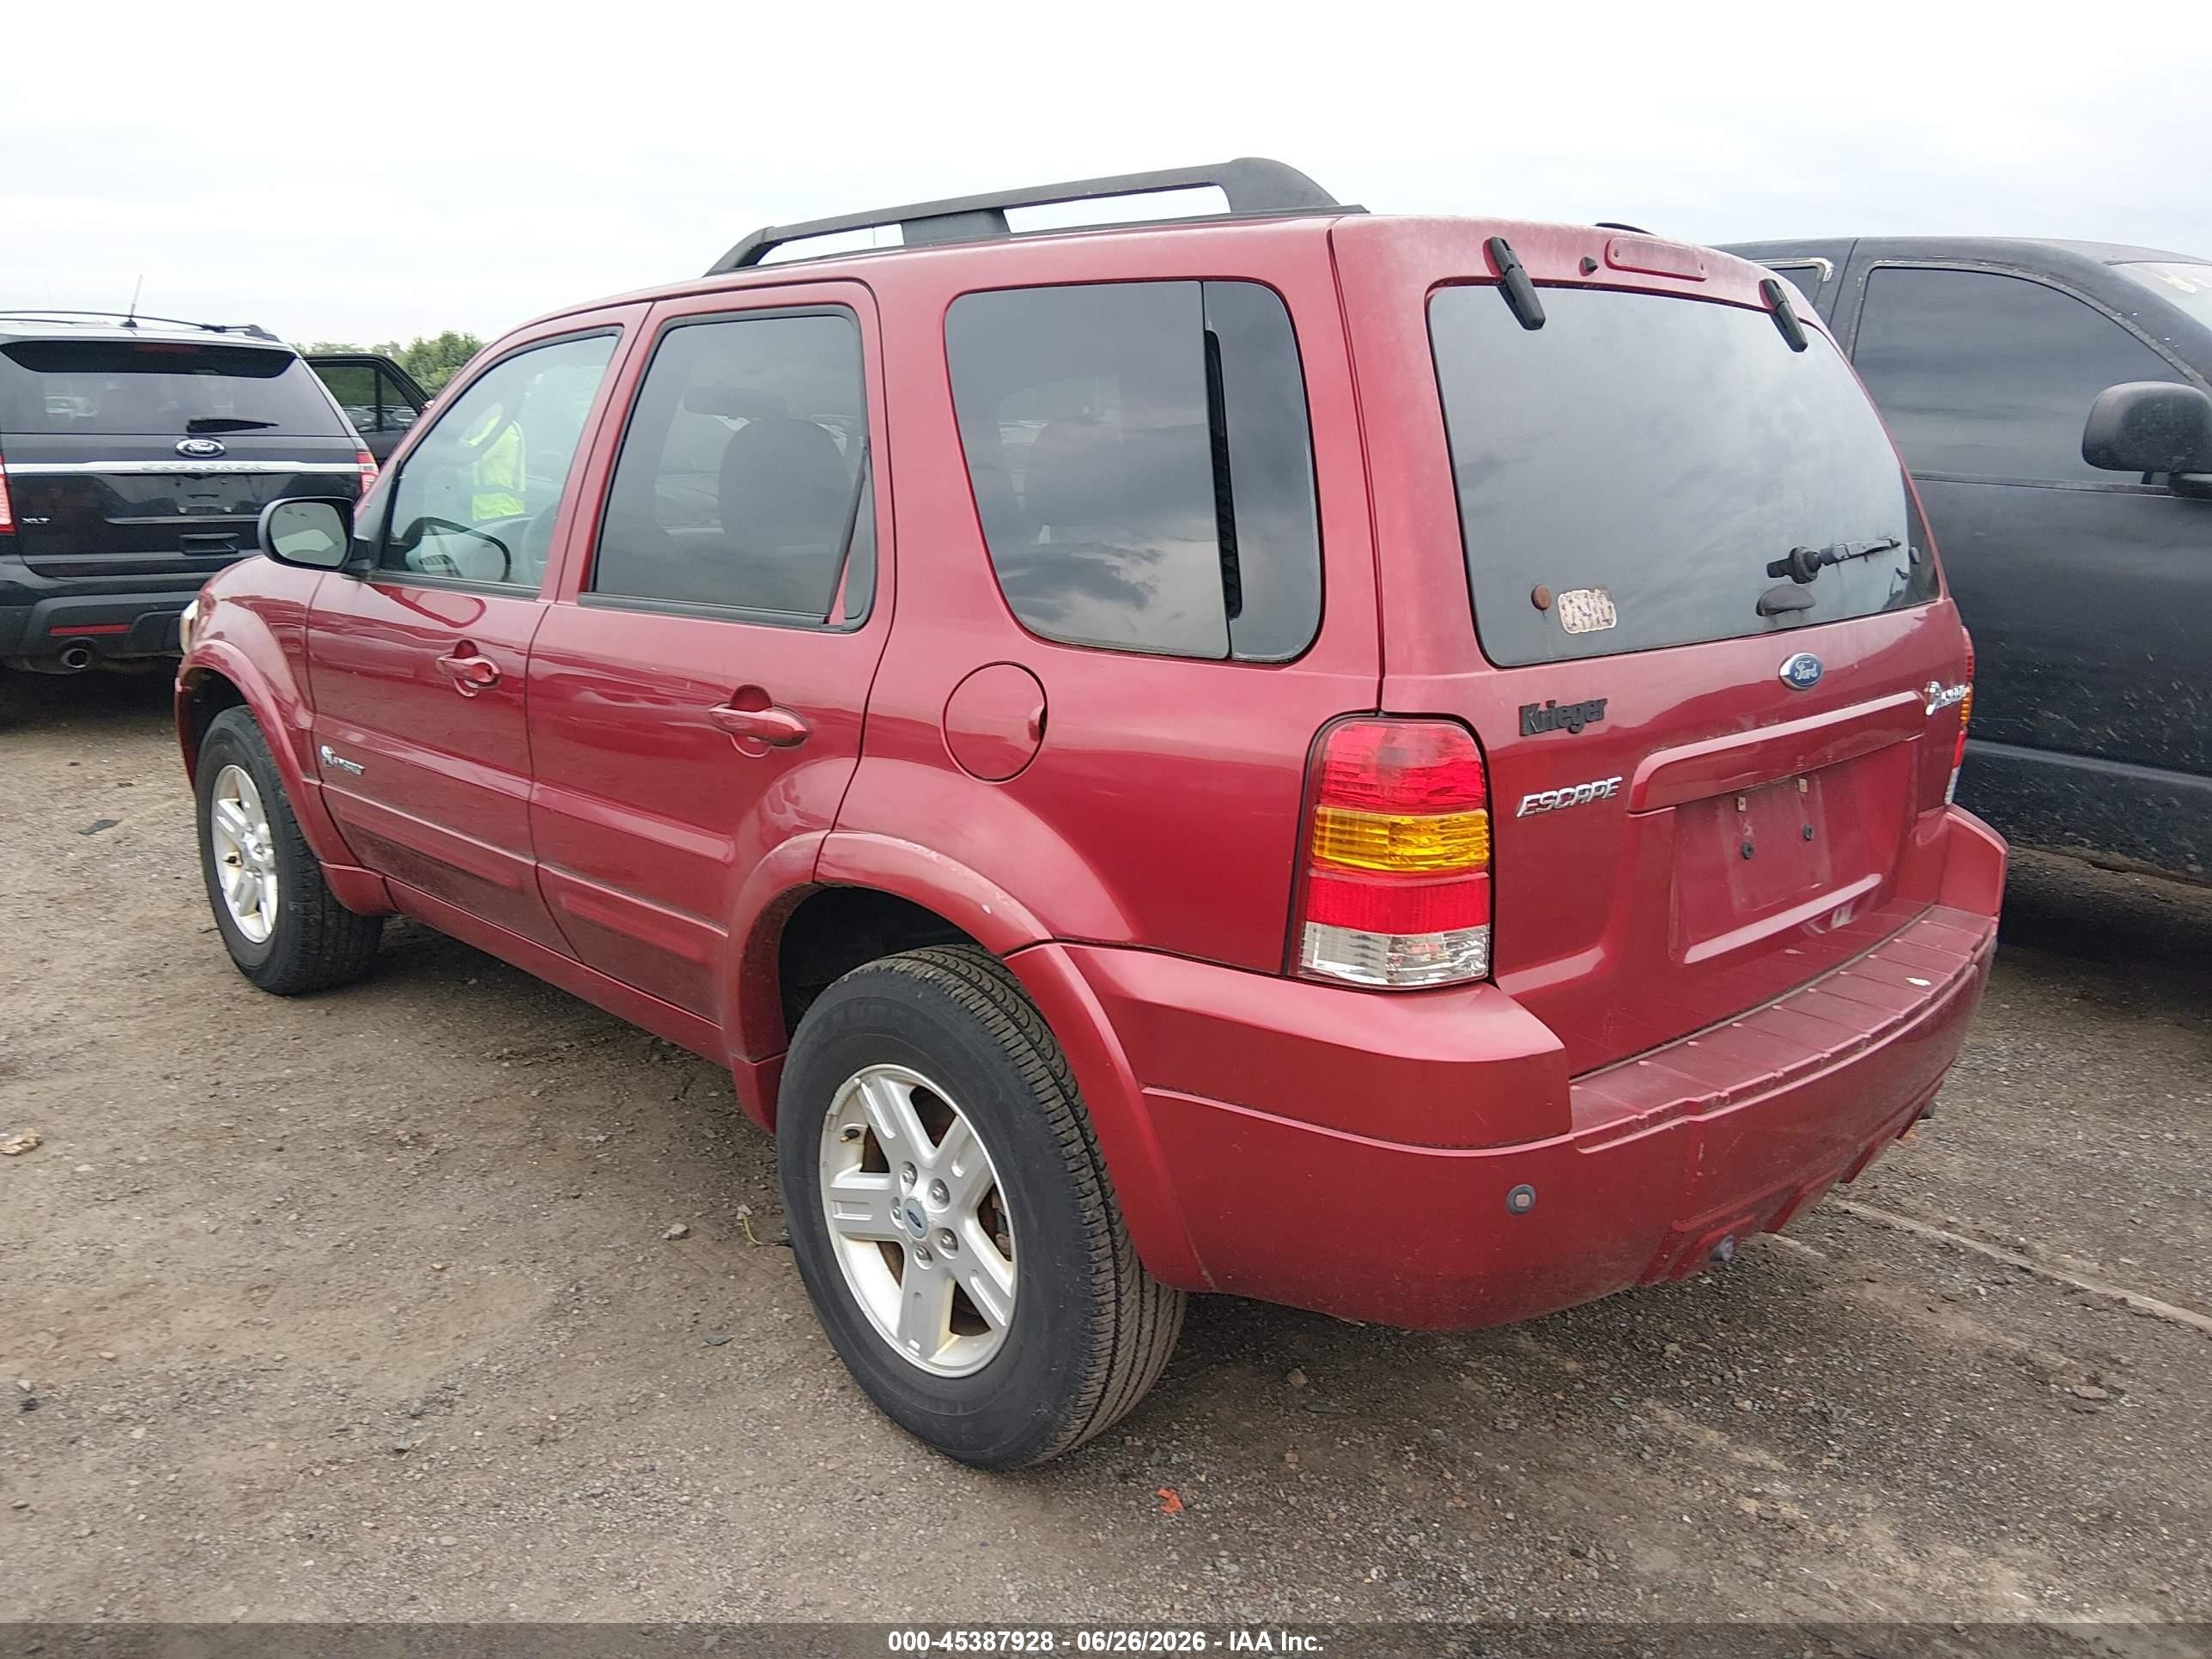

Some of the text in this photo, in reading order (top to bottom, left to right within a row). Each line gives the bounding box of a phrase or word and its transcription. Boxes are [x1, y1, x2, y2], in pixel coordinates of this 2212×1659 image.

[1794, 659, 1819, 680] Ford
[1518, 698, 1607, 737] Krieger
[1516, 775, 1623, 818] ESCAPE
